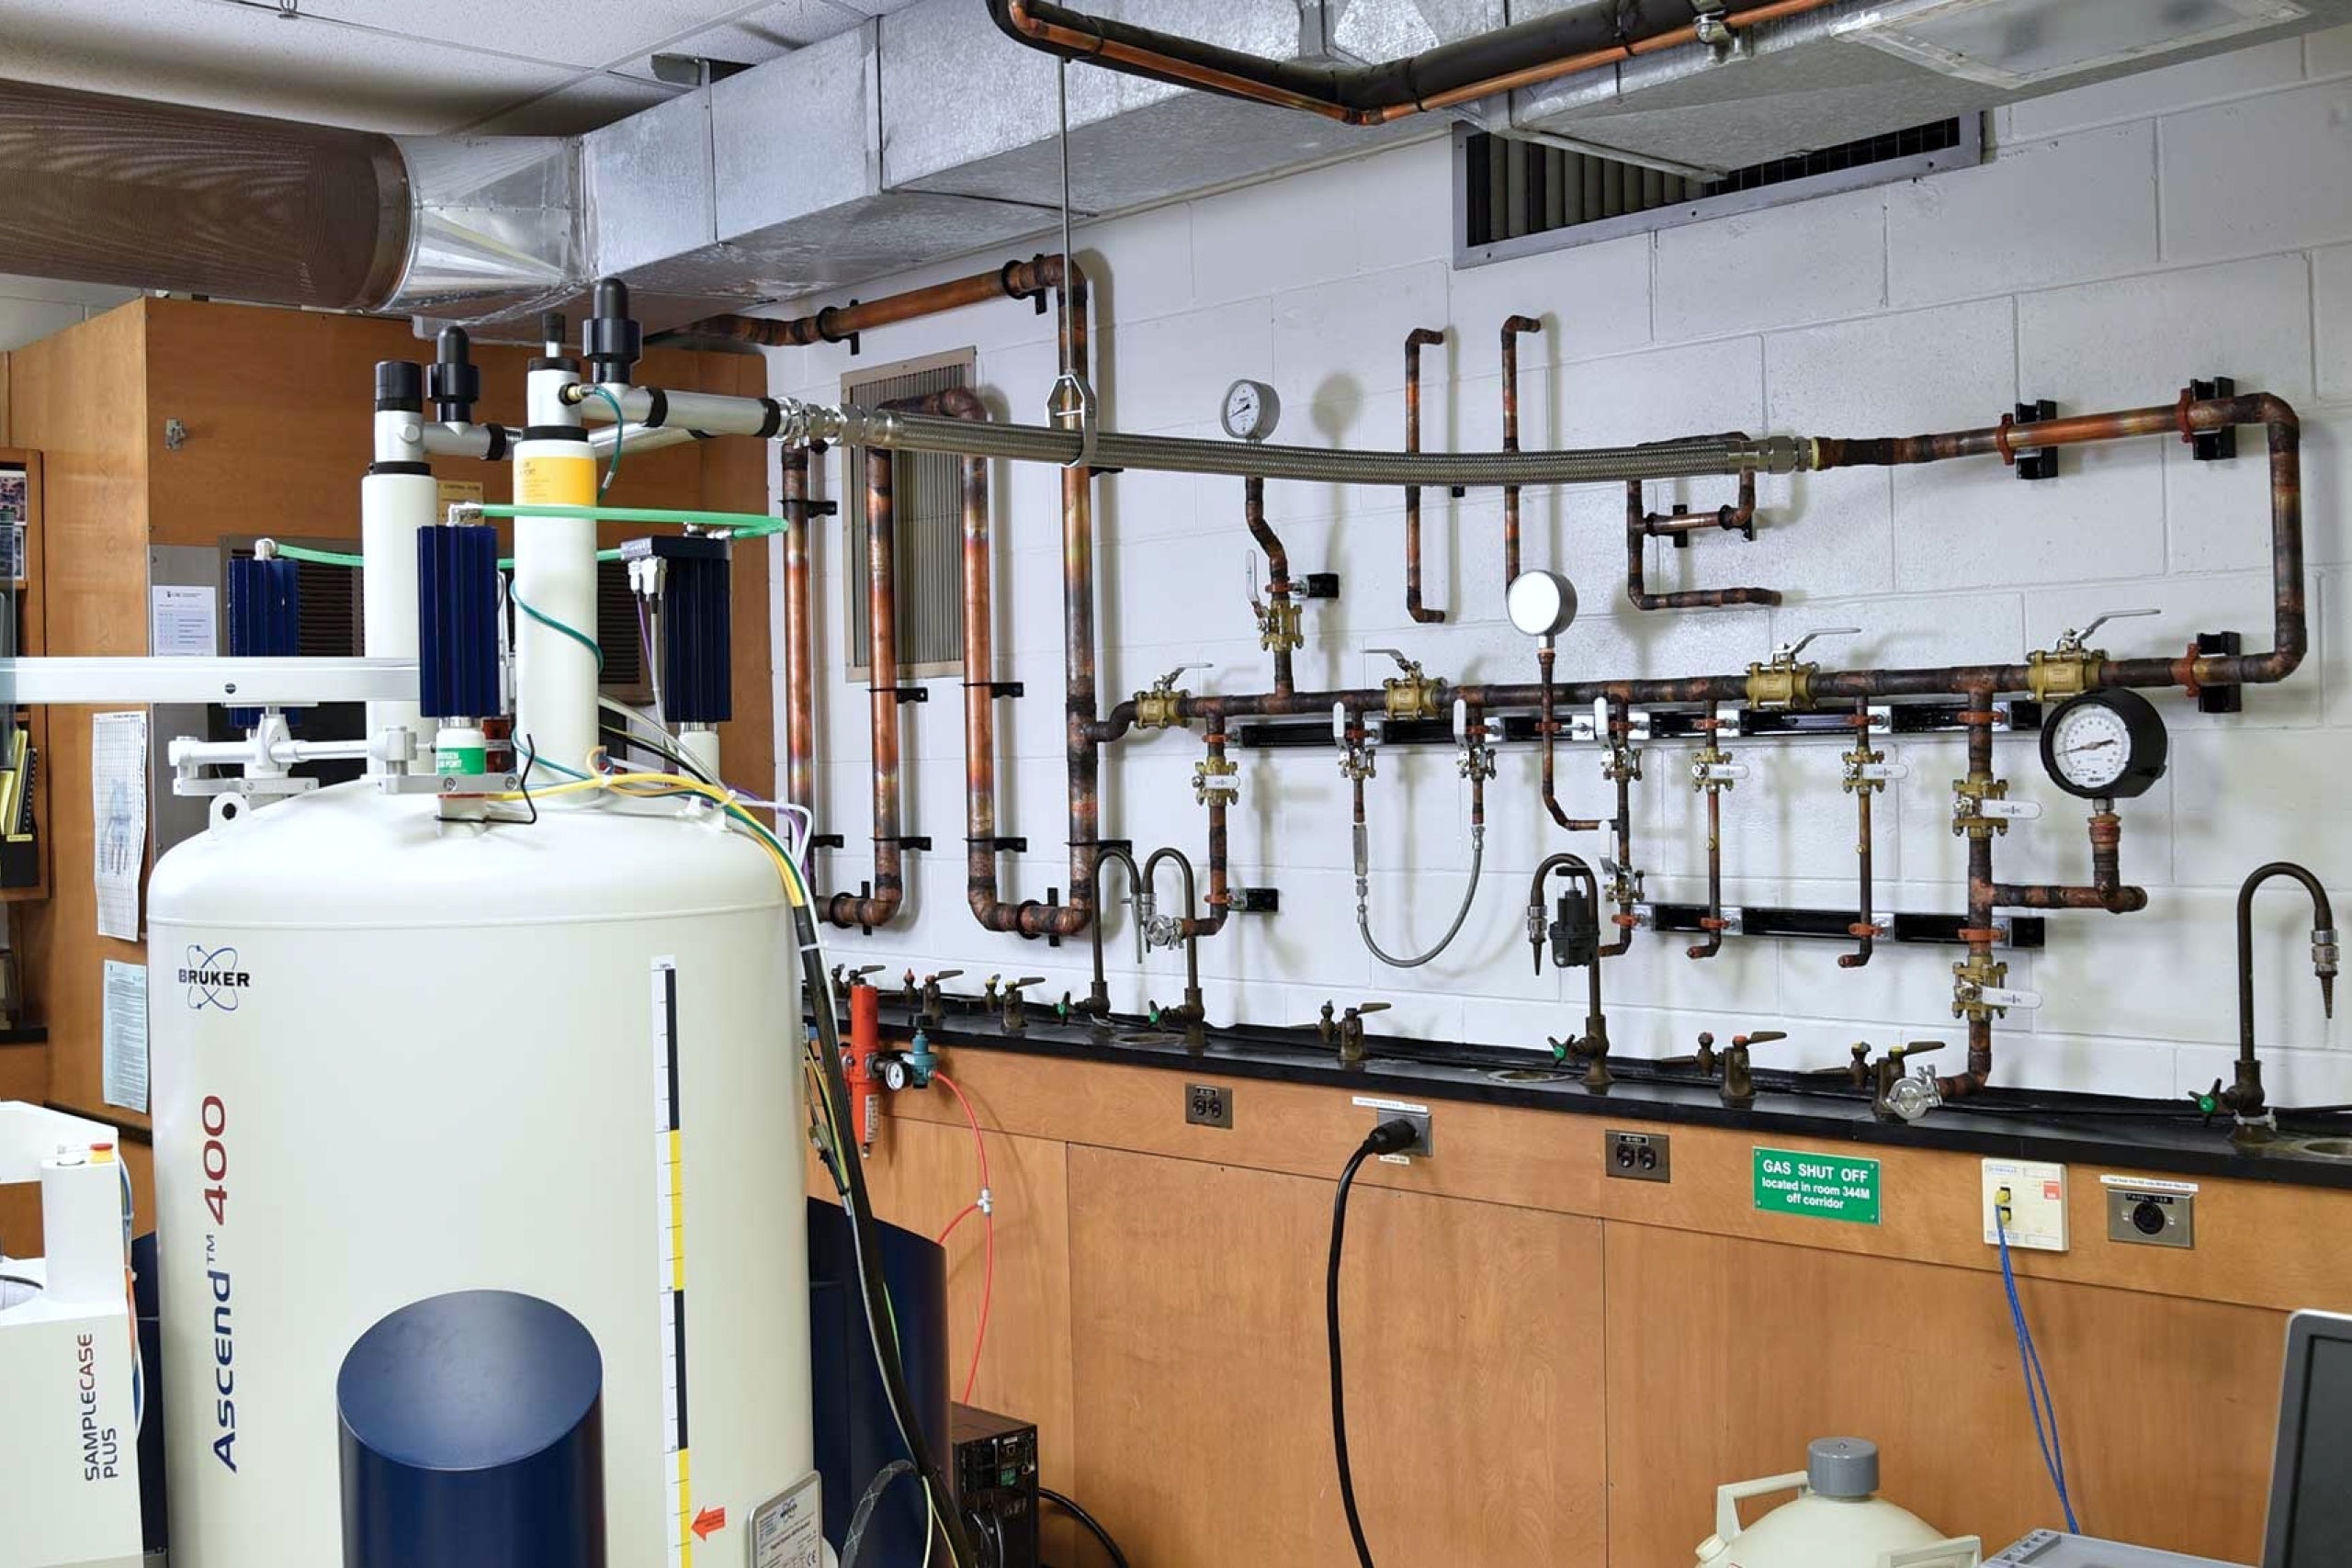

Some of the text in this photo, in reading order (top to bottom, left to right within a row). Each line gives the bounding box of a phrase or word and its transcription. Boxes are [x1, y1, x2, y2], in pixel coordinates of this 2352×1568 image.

[178, 968, 250, 987] BRUKER
[201, 1095, 228, 1226] 400
[1762, 1159, 1869, 1183] GAS SHUT OFF
[1761, 1177, 1870, 1200] located in room 344M
[1786, 1192, 1845, 1209] off corridor
[77, 1333, 100, 1482] SAMPLECASE
[101, 1427, 119, 1479] PLUS
